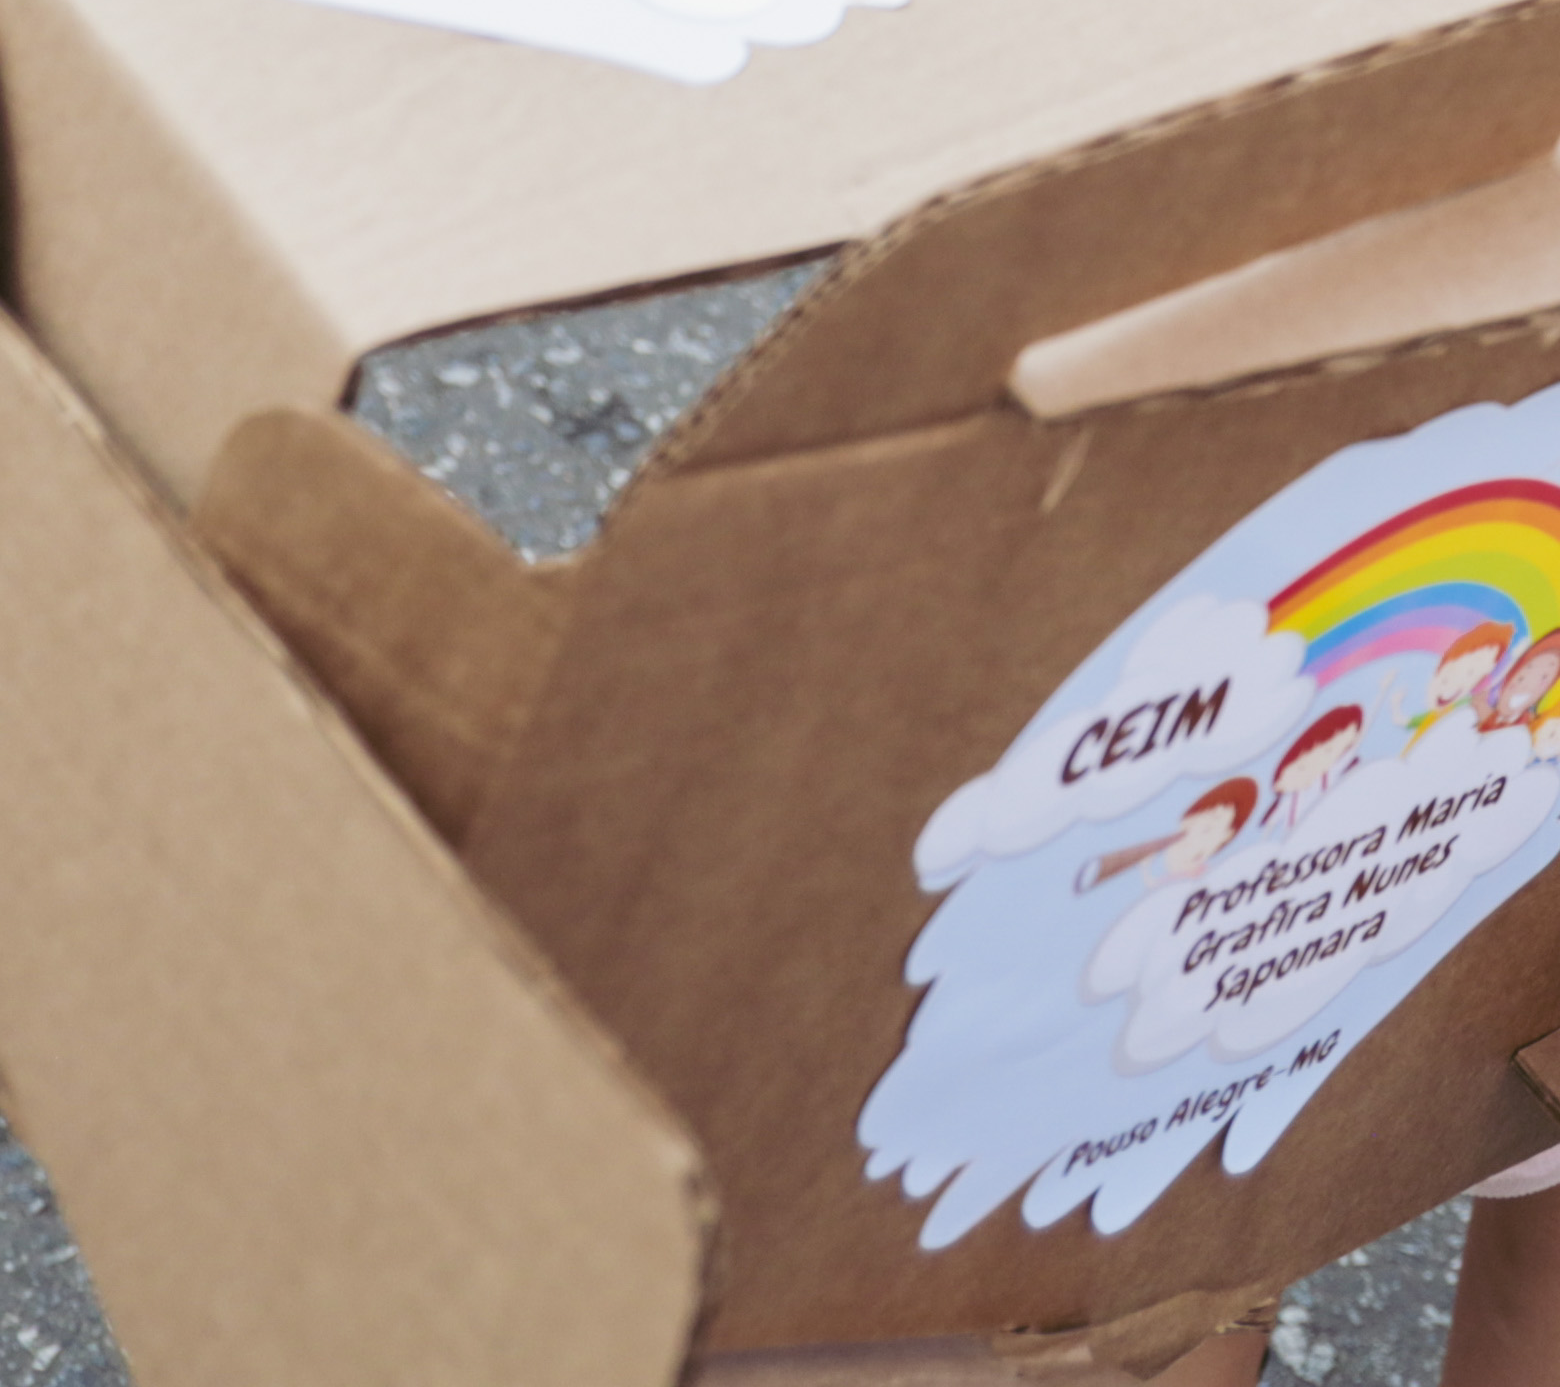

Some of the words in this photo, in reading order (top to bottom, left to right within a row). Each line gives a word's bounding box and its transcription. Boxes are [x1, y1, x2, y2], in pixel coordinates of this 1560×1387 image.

[1058, 675, 1231, 788] CEIM
[1172, 825, 1388, 935] Professora
[1396, 773, 1507, 844] Maria
[1182, 890, 1332, 975] Grafira
[1342, 834, 1461, 910] Nunes
[1203, 910, 1387, 1012] Saponara
[1063, 1117, 1159, 1177] Pouso
